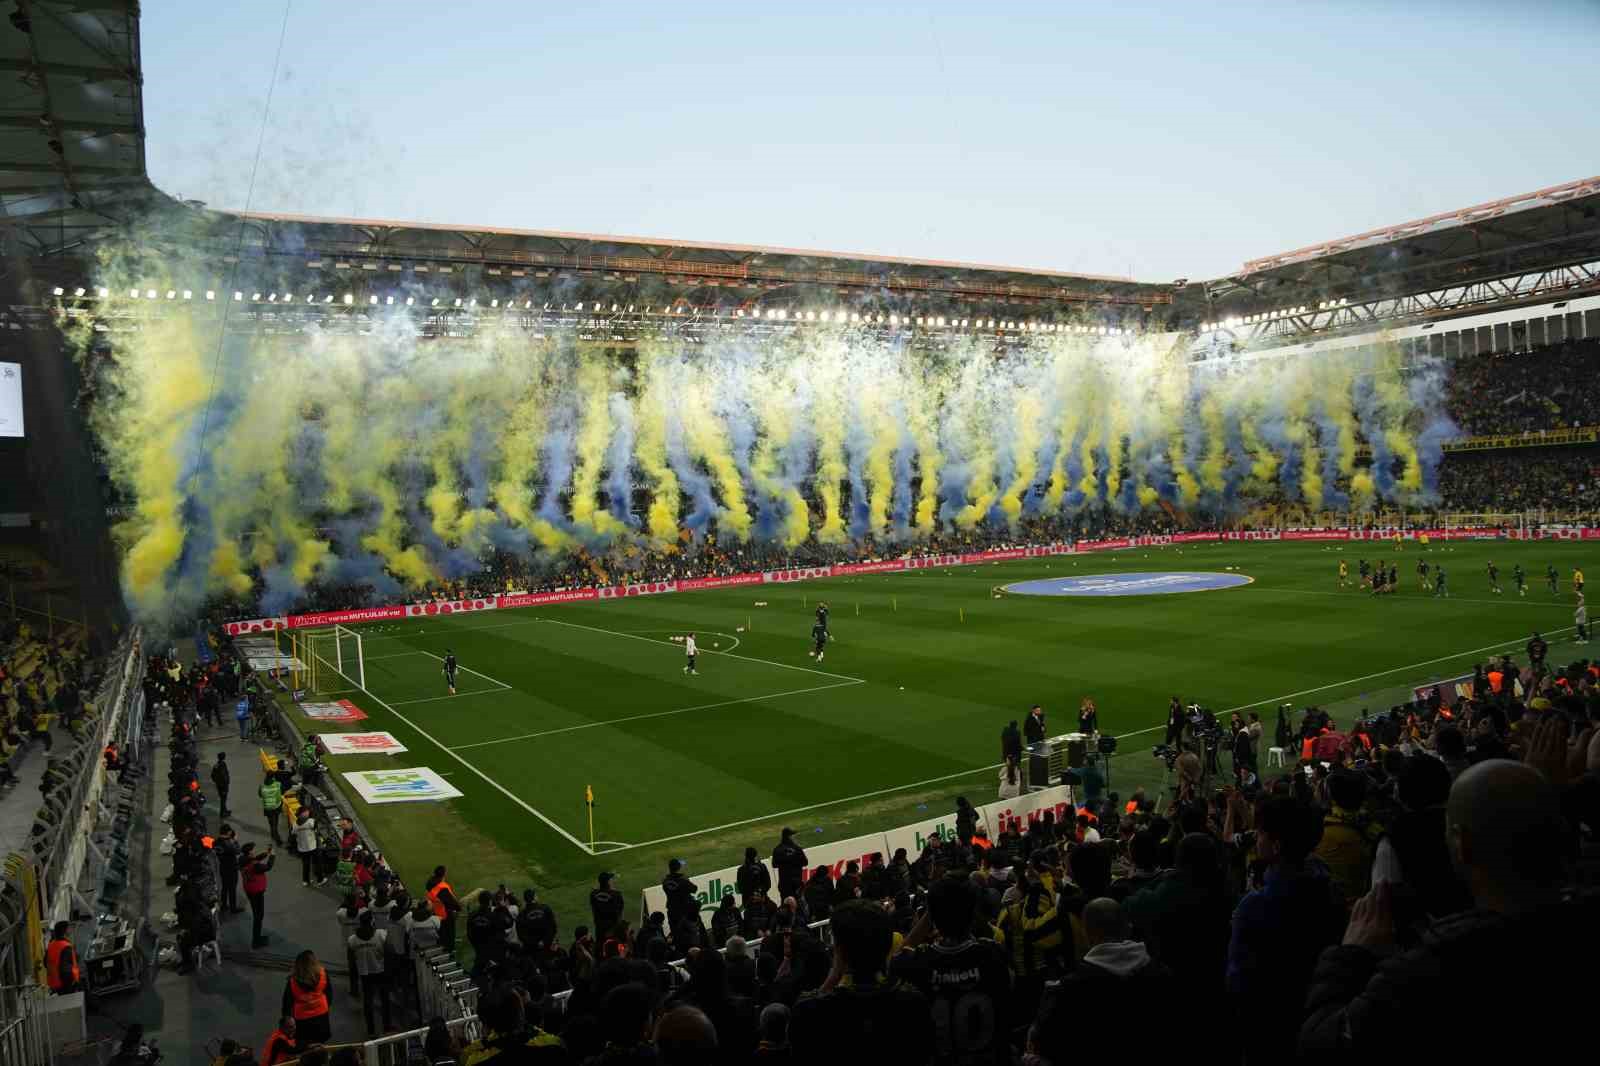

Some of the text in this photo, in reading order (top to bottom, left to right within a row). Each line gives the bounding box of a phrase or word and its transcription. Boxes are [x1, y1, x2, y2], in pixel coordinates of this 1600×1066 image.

[916, 823, 959, 851] hlle
[694, 878, 744, 904] alle
[928, 992, 995, 1055] 10
